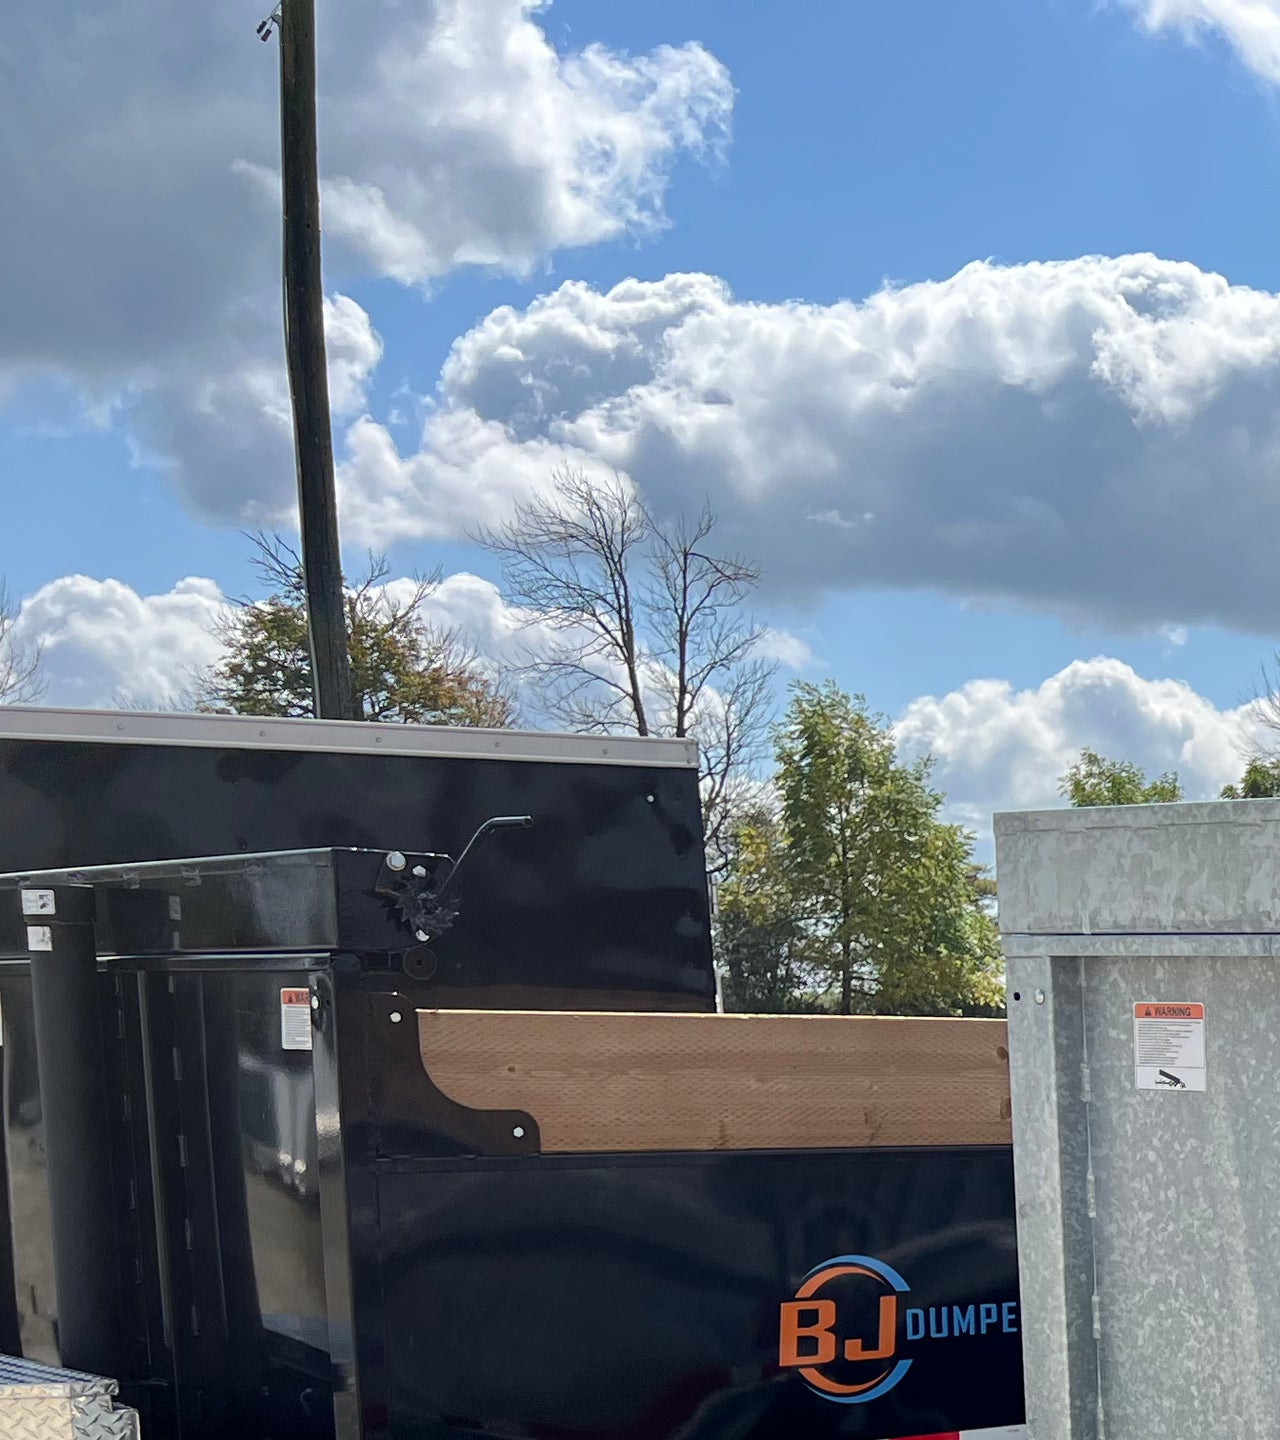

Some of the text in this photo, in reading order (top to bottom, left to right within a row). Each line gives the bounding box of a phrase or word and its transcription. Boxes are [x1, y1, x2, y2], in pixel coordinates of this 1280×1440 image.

[1154, 1006, 1191, 1016] WARNING
[779, 1294, 1018, 1368] BJ DUMPE
